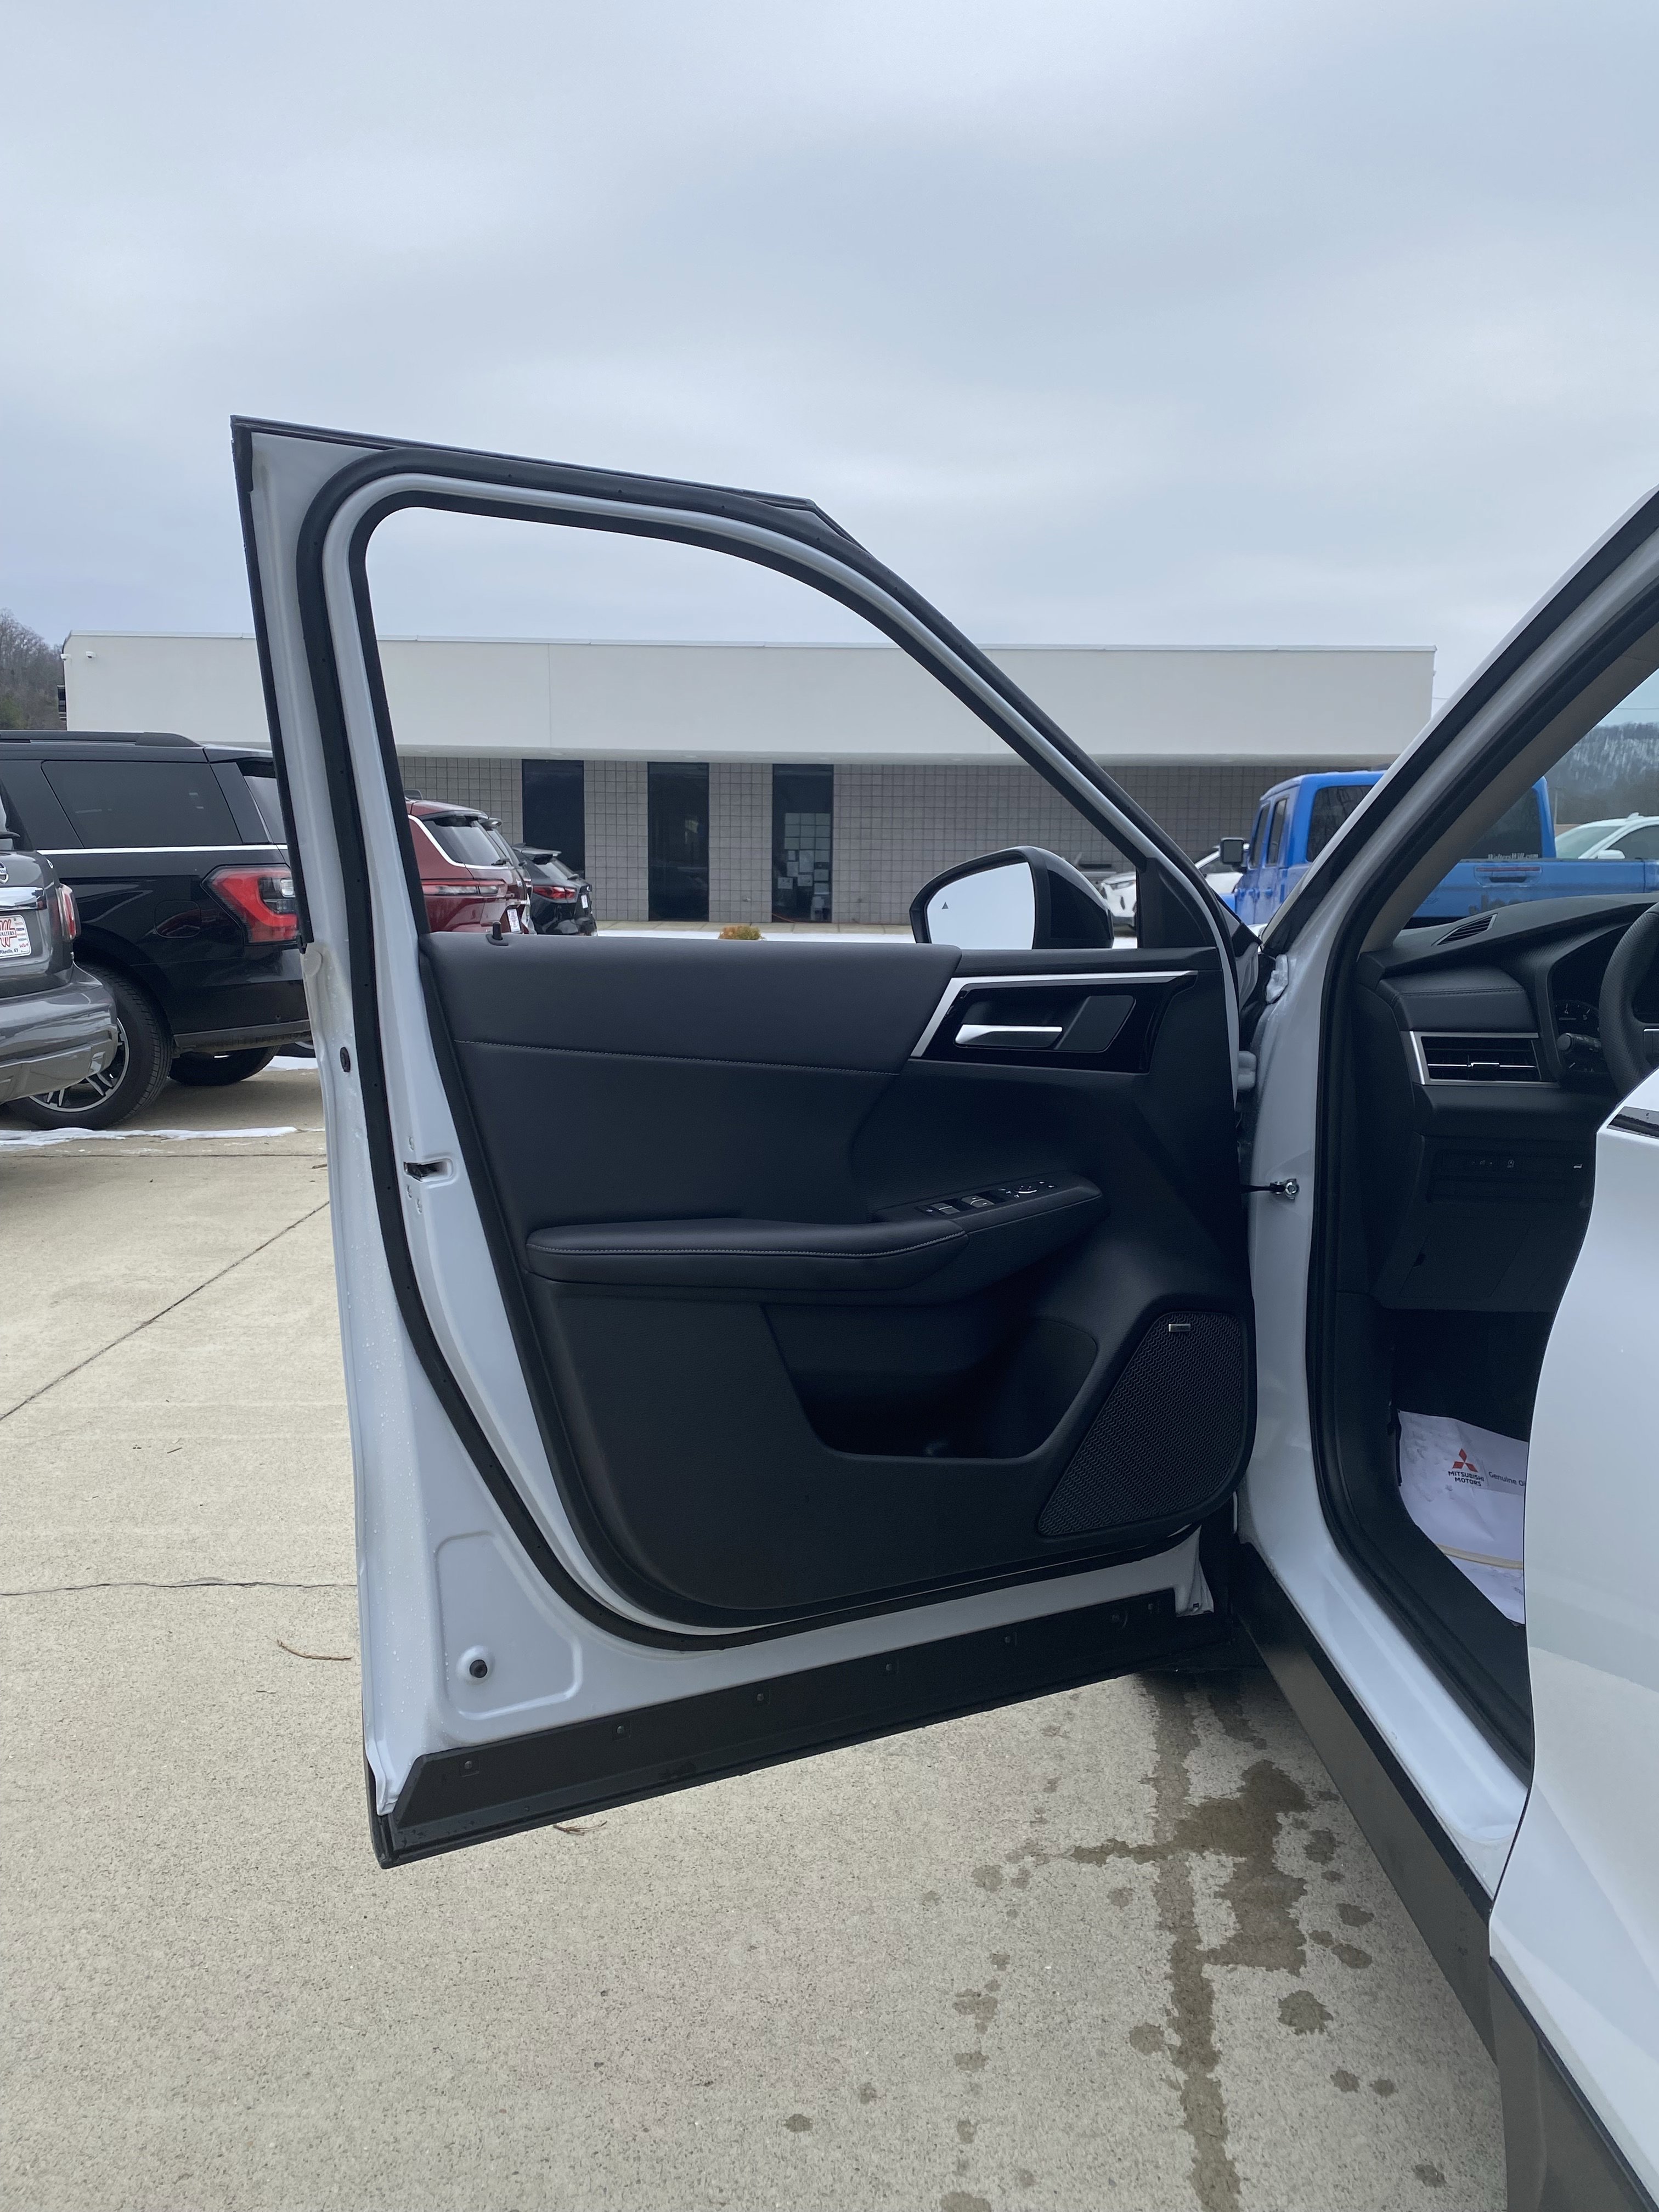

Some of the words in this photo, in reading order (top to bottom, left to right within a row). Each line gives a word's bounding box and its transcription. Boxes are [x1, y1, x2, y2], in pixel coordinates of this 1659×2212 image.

[1448, 1471, 1485, 1482] MITSUBISHI
[1454, 1477, 1481, 1486] MOTORS
[1488, 1471, 1517, 1485] Genuine
